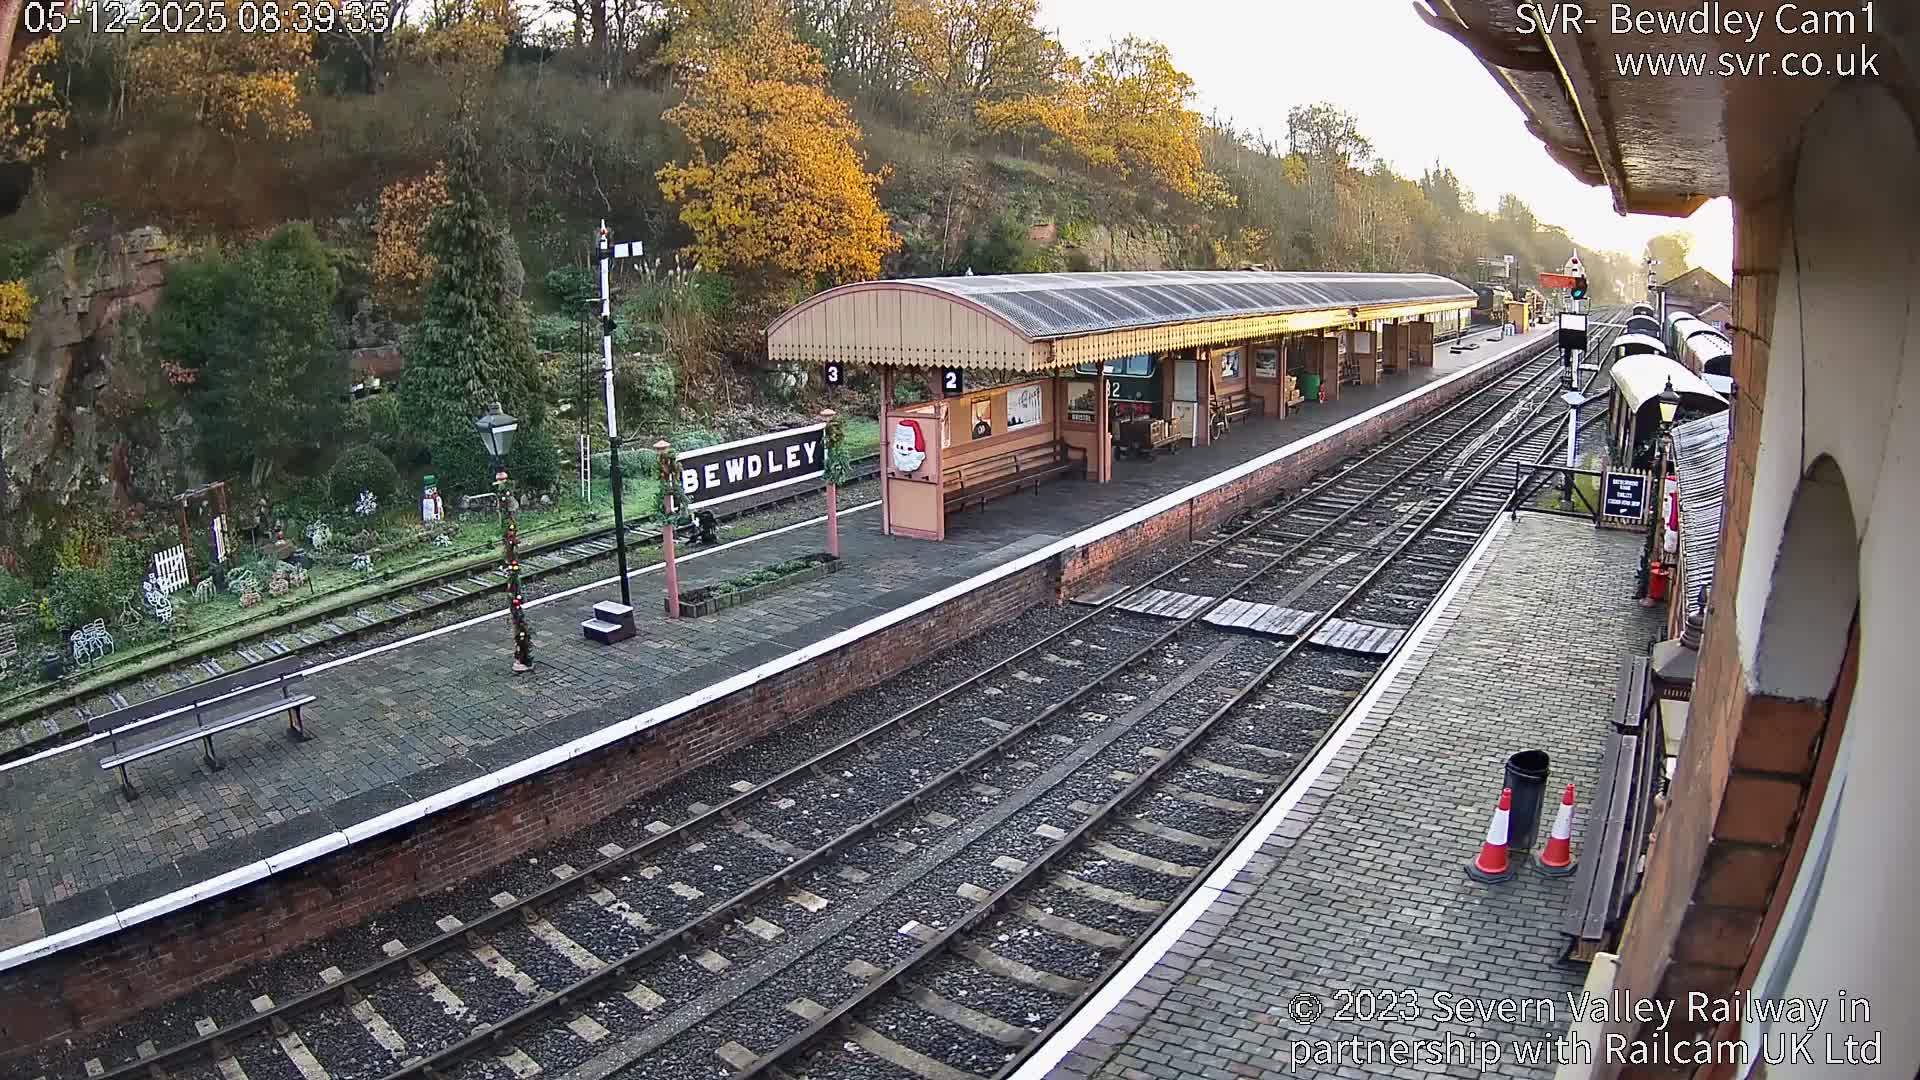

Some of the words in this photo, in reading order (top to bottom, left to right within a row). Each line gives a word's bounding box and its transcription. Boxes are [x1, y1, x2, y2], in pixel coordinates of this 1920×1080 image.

[827, 366, 839, 382] 3
[944, 372, 958, 389] 2
[681, 440, 817, 494] BEWDLEY
